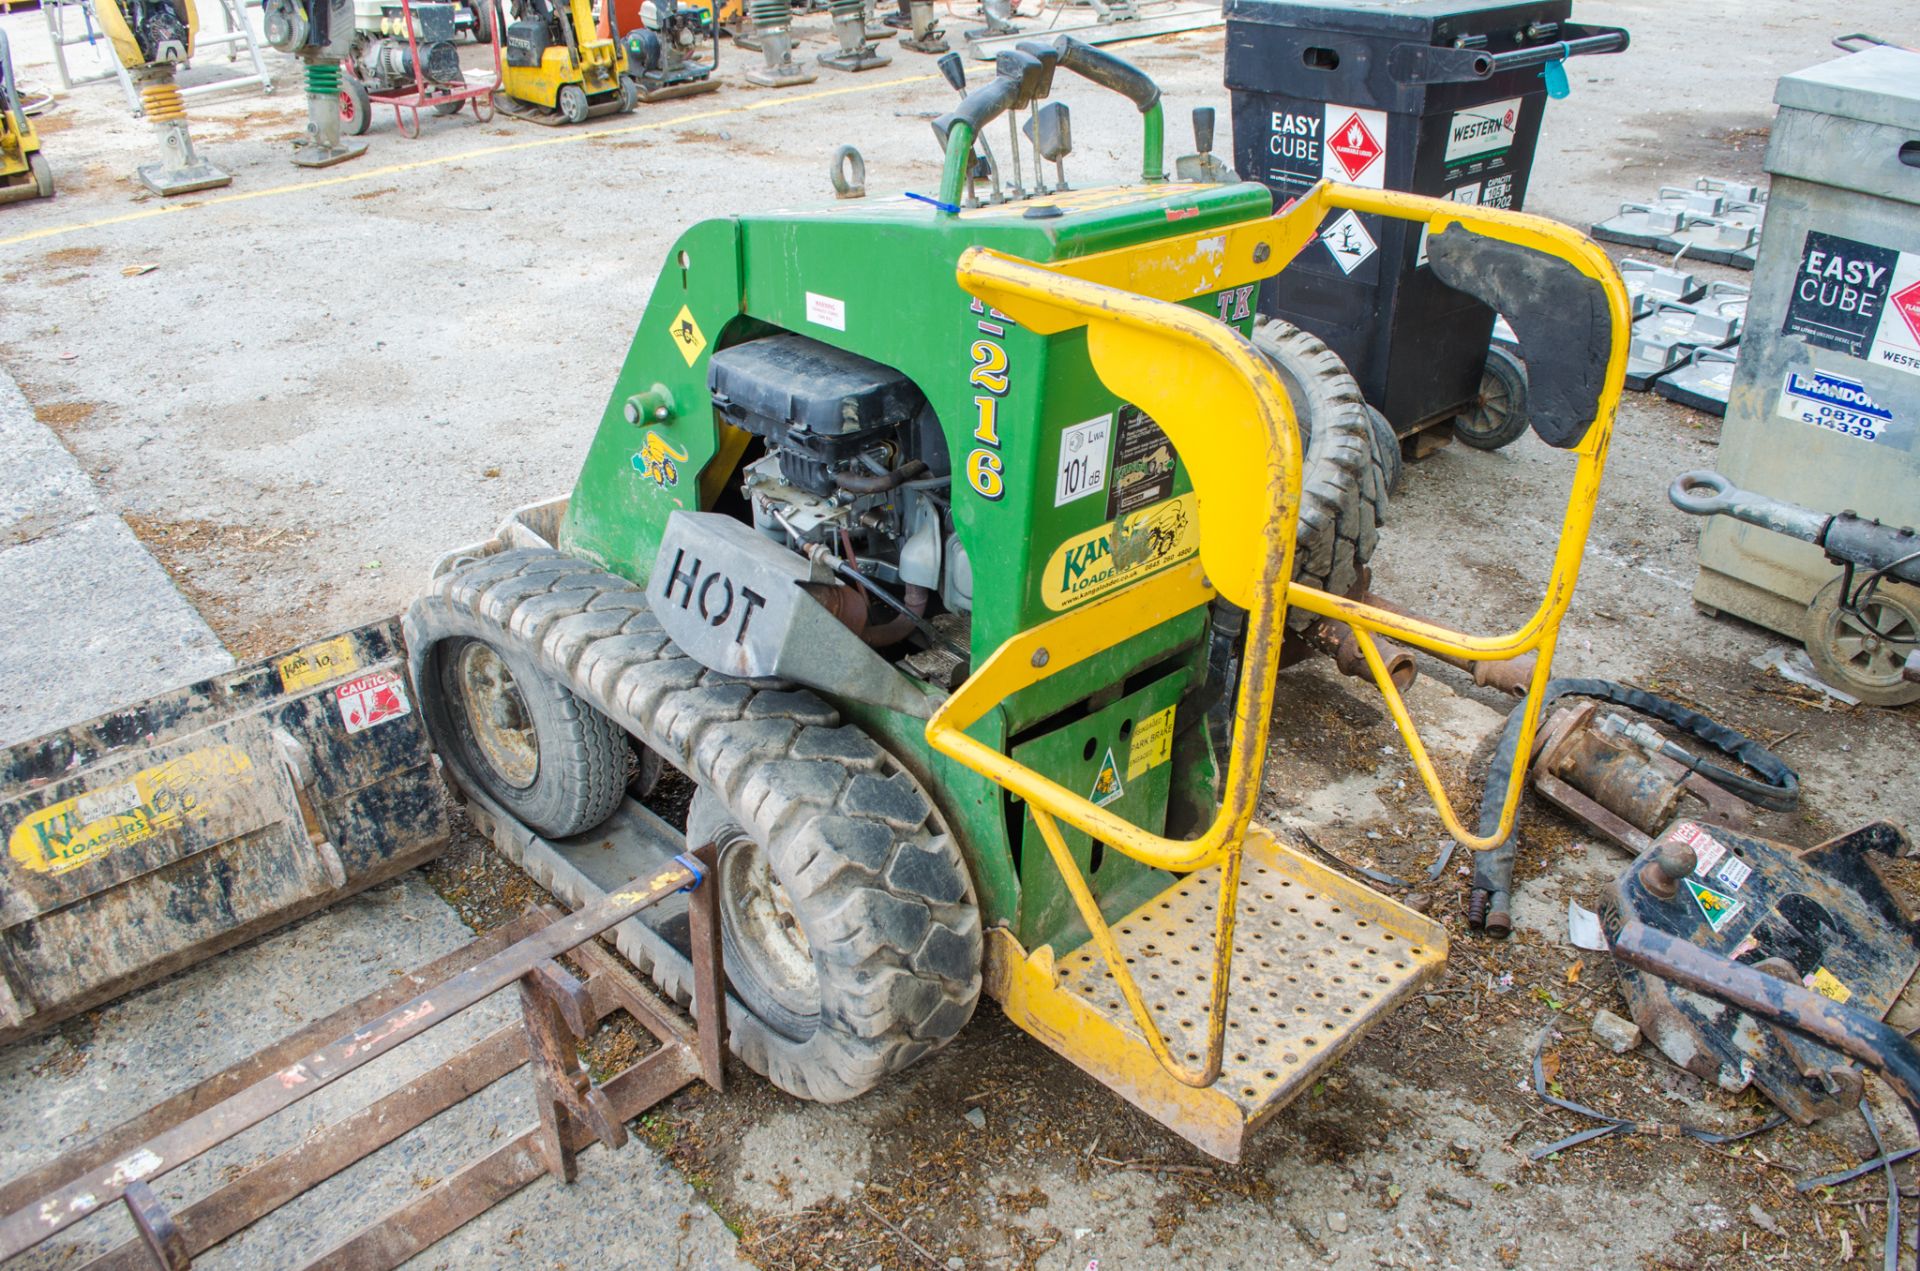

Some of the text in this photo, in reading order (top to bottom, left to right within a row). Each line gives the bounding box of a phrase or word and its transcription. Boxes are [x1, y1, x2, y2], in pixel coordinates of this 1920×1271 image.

[1271, 111, 1320, 138] EASY
[1453, 117, 1502, 142] WESTERN
[1269, 134, 1319, 161] CUBE
[1806, 250, 1886, 288] EASY
[1217, 285, 1254, 322] TK
[1800, 278, 1877, 317] CUBE
[1802, 412, 1876, 440] 514339
[1820, 406, 1873, 428] 0870
[1064, 455, 1101, 495] 101 dB
[1072, 563, 1130, 593] LOADES
[664, 548, 767, 646] HOT
[1150, 723, 1172, 742] BRAKE
